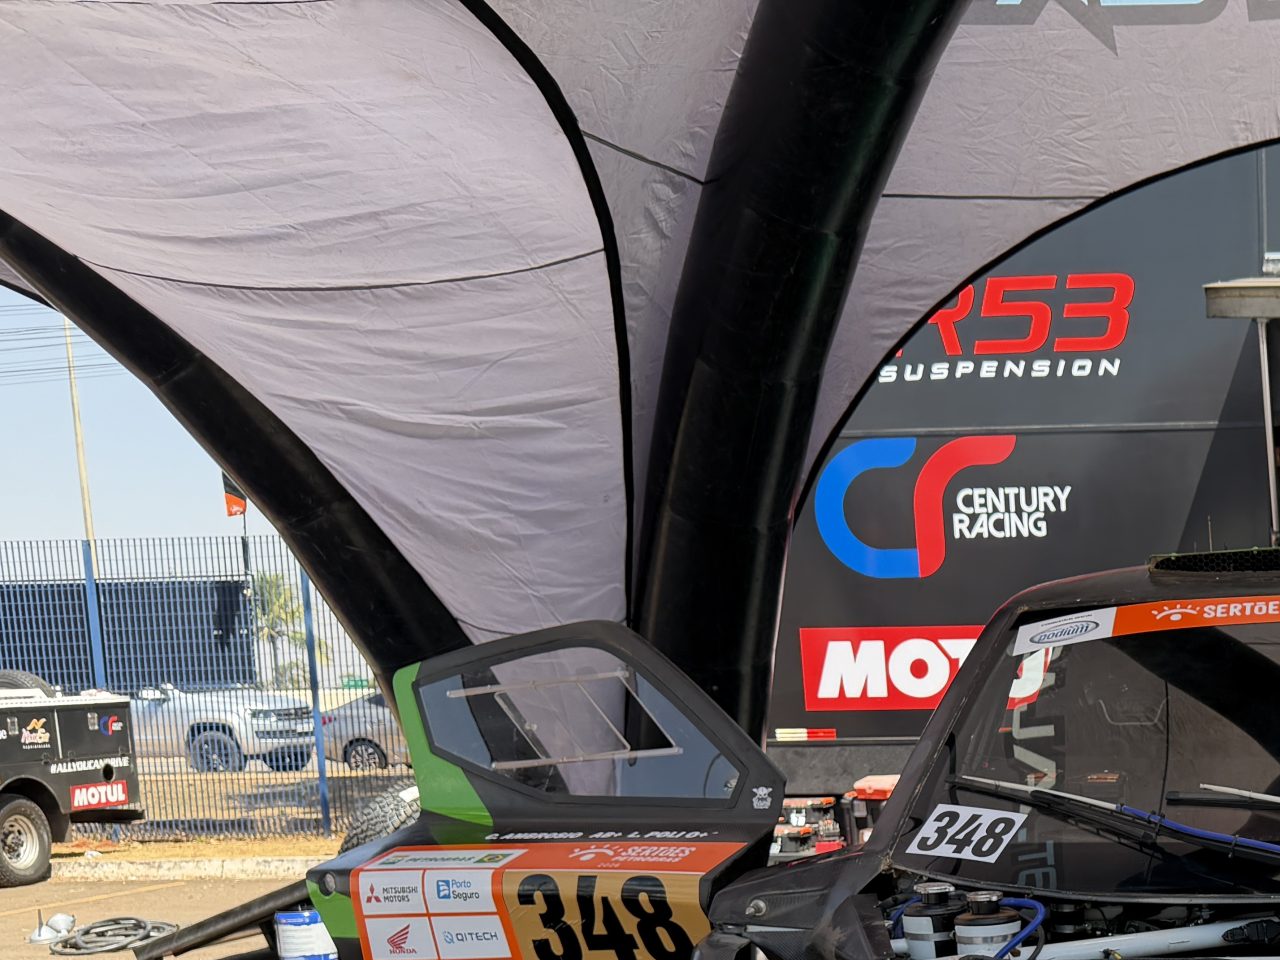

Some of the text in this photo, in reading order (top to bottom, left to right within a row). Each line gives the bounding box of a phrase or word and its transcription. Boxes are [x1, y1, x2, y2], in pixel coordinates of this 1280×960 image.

[878, 357, 1121, 383] SUSPENSION
[956, 485, 1072, 515] CENTURY
[952, 511, 1048, 539] RACING
[73, 783, 126, 807] MOTUL
[916, 811, 1016, 858] 348
[382, 886, 418, 894] MITSUBISHI
[451, 879, 472, 889] Porto
[383, 895, 410, 903] MOTORS
[451, 891, 480, 902] Seguro
